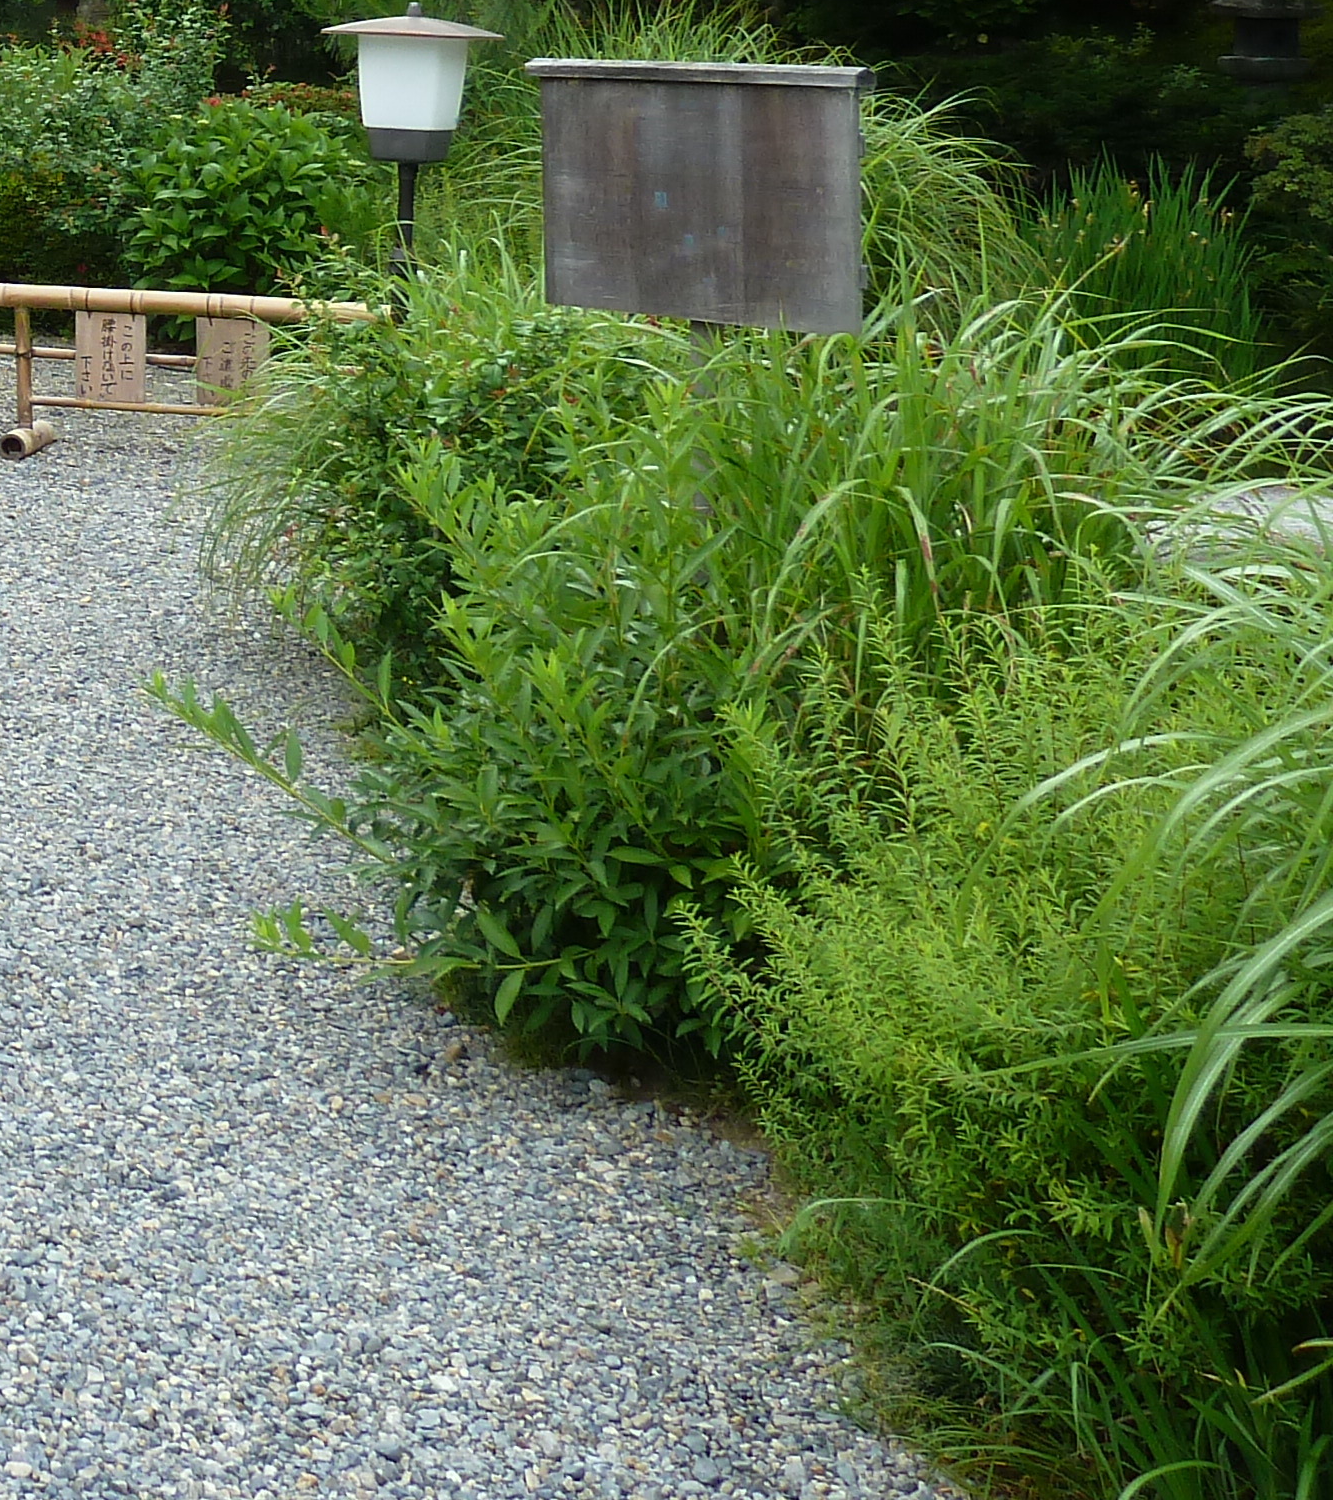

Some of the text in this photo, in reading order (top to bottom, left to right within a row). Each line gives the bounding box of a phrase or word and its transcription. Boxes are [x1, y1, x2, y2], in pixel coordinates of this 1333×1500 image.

[80, 355, 93, 395] 下さい
[118, 324, 135, 381] この上に
